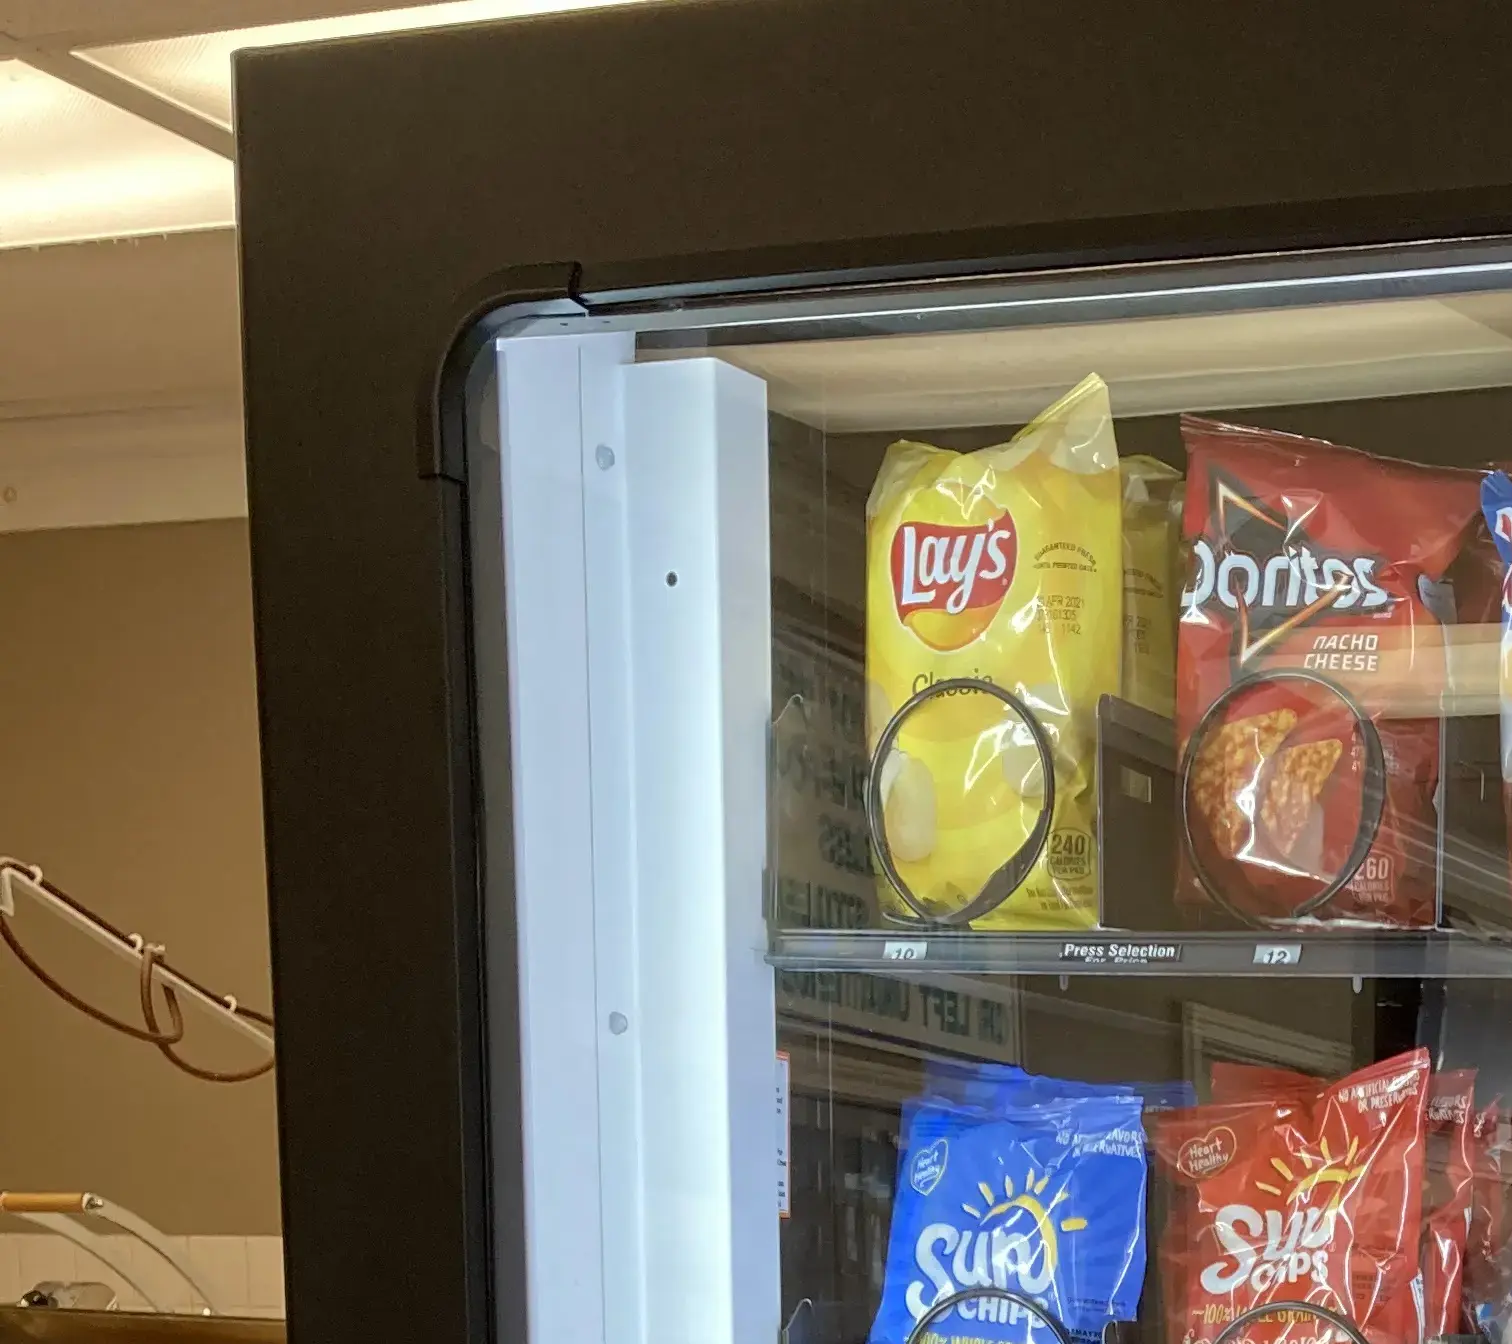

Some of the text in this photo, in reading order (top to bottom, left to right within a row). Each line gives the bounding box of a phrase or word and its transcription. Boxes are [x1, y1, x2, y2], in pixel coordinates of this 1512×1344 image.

[901, 518, 1011, 615] Lay's
[1313, 634, 1378, 651] NACHO
[1304, 653, 1378, 671] CHEESE
[1052, 834, 1085, 855] 240
[1064, 943, 1175, 957] Press Selection
[1189, 1137, 1223, 1157] Heart
[1188, 1153, 1229, 1172] Healthy
